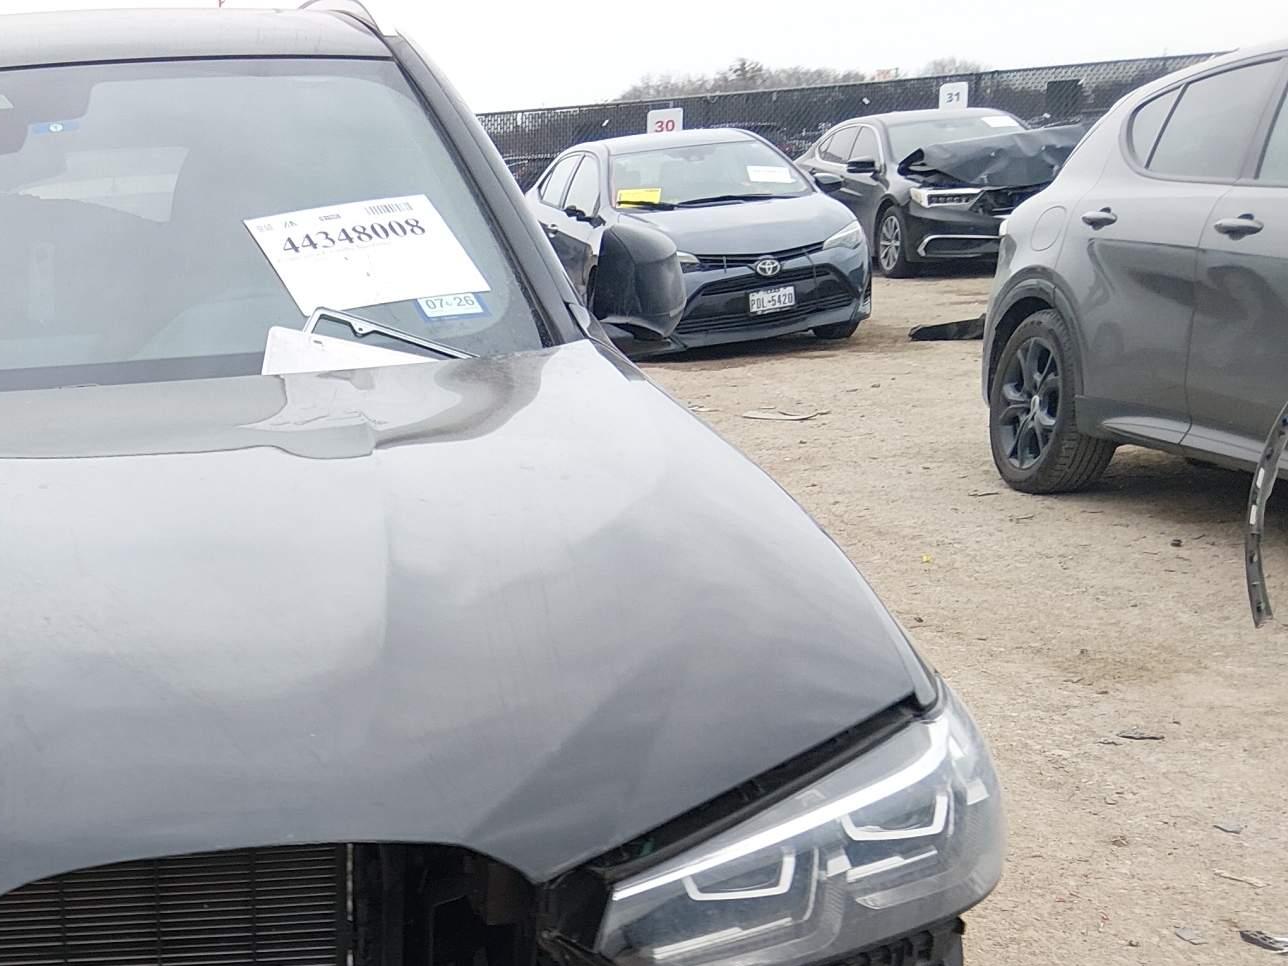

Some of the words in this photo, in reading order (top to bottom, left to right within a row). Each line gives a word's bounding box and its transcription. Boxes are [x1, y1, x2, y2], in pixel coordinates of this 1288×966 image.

[945, 91, 961, 104] 31
[654, 119, 676, 133] 30
[282, 217, 426, 254] 44348008
[425, 297, 445, 310] 07
[453, 295, 475, 307] 26
